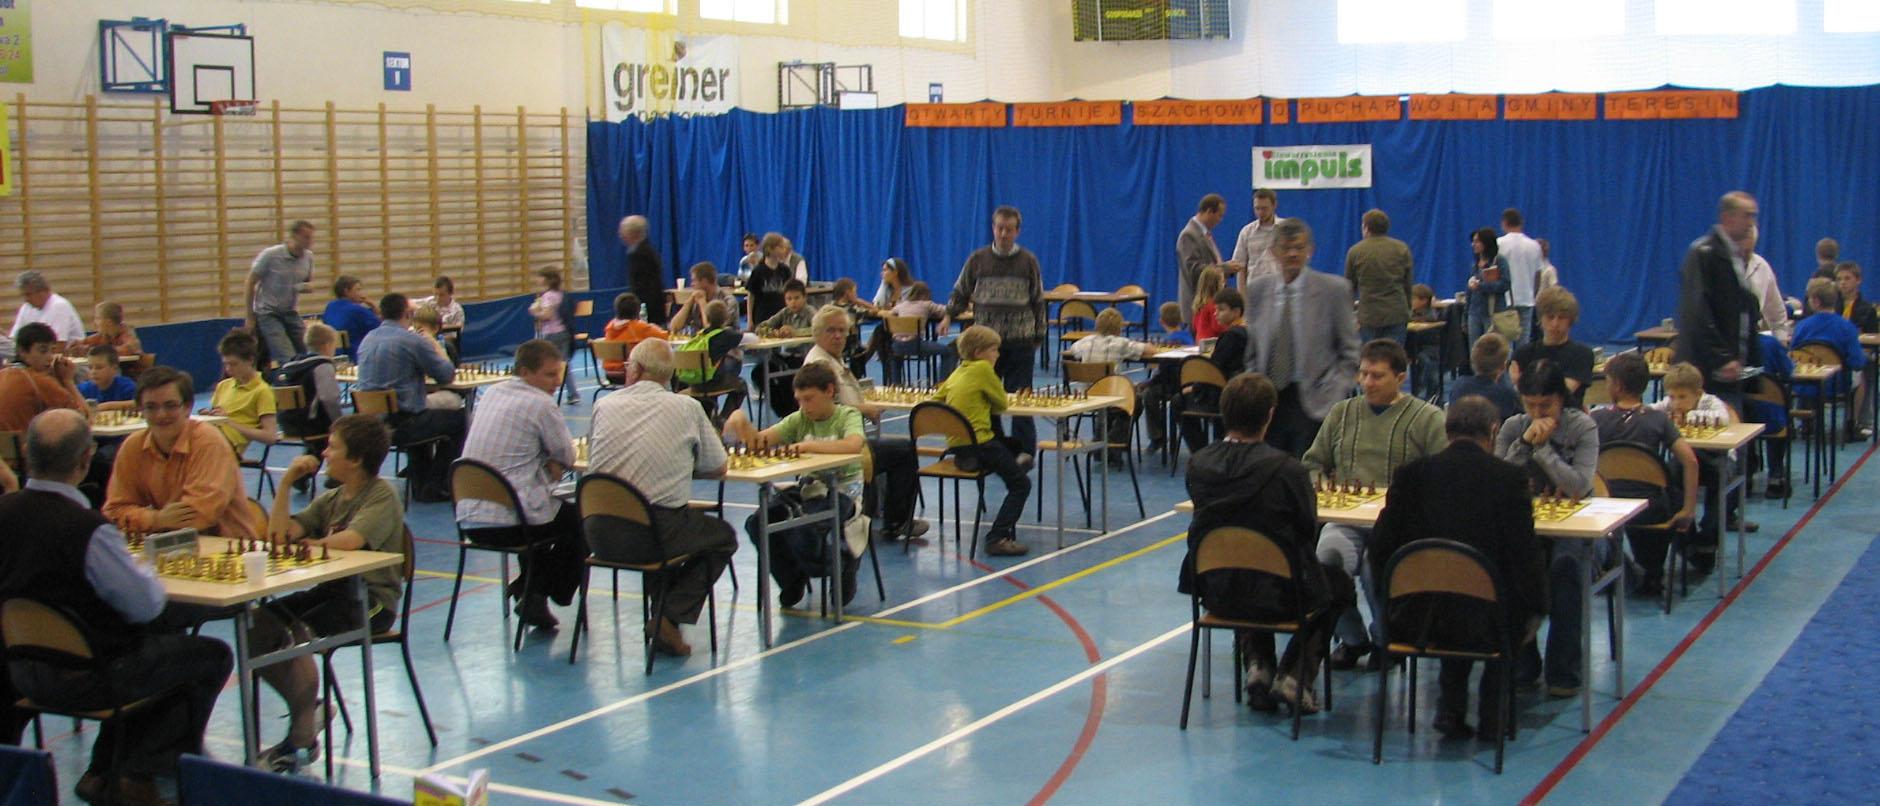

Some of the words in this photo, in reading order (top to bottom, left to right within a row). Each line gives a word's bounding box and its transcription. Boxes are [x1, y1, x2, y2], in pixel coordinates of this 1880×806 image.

[613, 60, 730, 111] greiner
[907, 106, 1001, 121] OTWARTY
[1016, 103, 1118, 121] TURNIEJ
[1137, 102, 1259, 119] SZACHOWY
[1273, 102, 1285, 116] O
[1301, 100, 1397, 116] PUCHAR
[1507, 96, 1590, 113] GMINY
[1609, 94, 1734, 112] TERESIN
[1263, 151, 1363, 186] impuls
